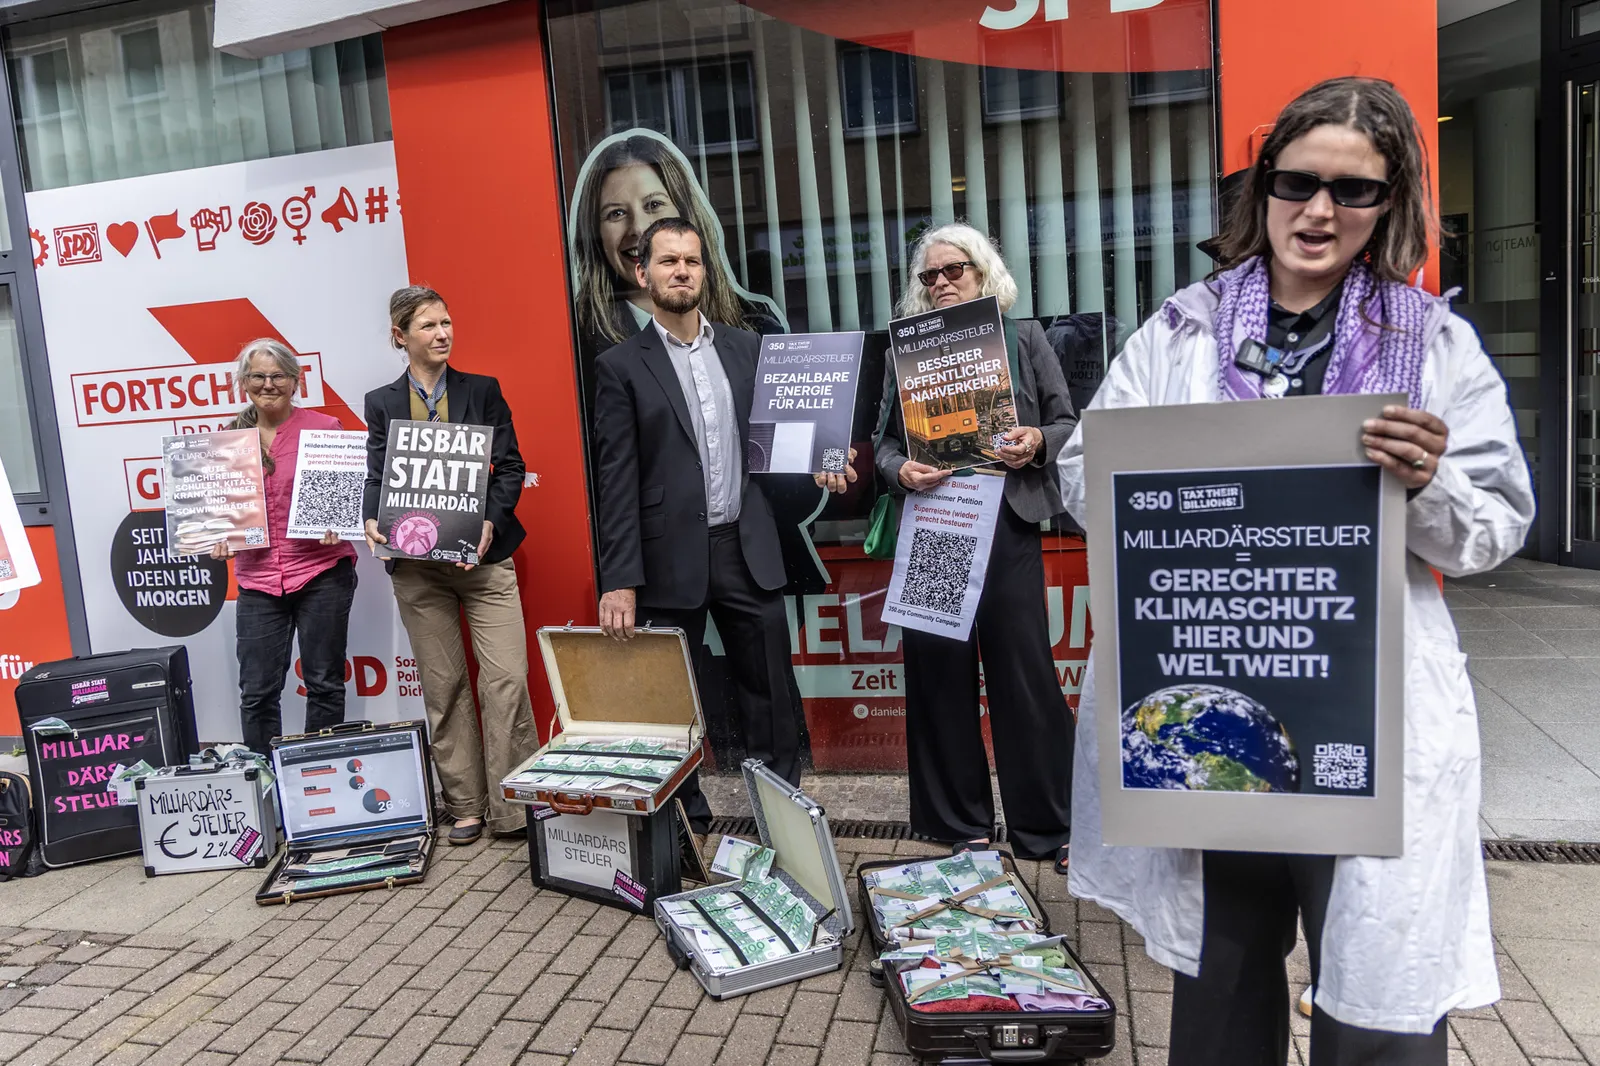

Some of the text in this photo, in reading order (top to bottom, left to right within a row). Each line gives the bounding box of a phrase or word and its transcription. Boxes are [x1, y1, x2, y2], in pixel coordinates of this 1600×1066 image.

[898, 326, 915, 338] 350
[898, 323, 995, 355] MILLIARDÄRSSTEUER
[768, 342, 785, 350] 350
[763, 353, 854, 365] MILLIARDÄRSSTEUER
[917, 348, 983, 373] BESSERER
[763, 372, 850, 384] BEZAHLBARE
[904, 358, 1001, 391] ÖFFENTLICHER
[775, 385, 833, 397] ENERGIE
[911, 374, 1000, 404] NAHVERKEHR
[768, 397, 834, 409] FÜR ALLE!
[396, 425, 486, 456] EISBÄR
[304, 453, 342, 461] Superreiche
[389, 456, 483, 492] STATT
[951, 481, 980, 491] Billions!
[1182, 487, 1238, 499] TAX THEIR
[205, 496, 227, 505] UND
[386, 492, 479, 513] MILLIARDÄR
[957, 496, 983, 506] Petition
[1132, 491, 1173, 510] 350
[1183, 497, 1237, 509] BILLIONS!
[913, 504, 979, 520] Superreiche (wieder)
[915, 515, 973, 529] gerecht besteuern
[131, 527, 164, 545] SEIT
[1123, 524, 1371, 549] MILLIARDÄRSSTEUER
[127, 565, 212, 587] IDEEN FÜR
[1149, 567, 1337, 592] GERECHTER
[136, 589, 210, 607] MORGEN
[888, 605, 961, 628] 350.org Community Campaign
[1134, 596, 1355, 620] KLIMASCHUTZ
[1172, 625, 1314, 648] HIER UND
[1157, 653, 1329, 678] WELTWEIT!
[71, 678, 106, 690] EISBÄR STATT
[851, 668, 898, 691] Zeit
[72, 685, 107, 696] MILLIARDÄR
[378, 801, 394, 811] 26
[188, 811, 246, 837] STEUER
[548, 827, 627, 855] MILLIARDÄRS
[564, 847, 612, 868] STEUER
[743, 941, 765, 954] 100
